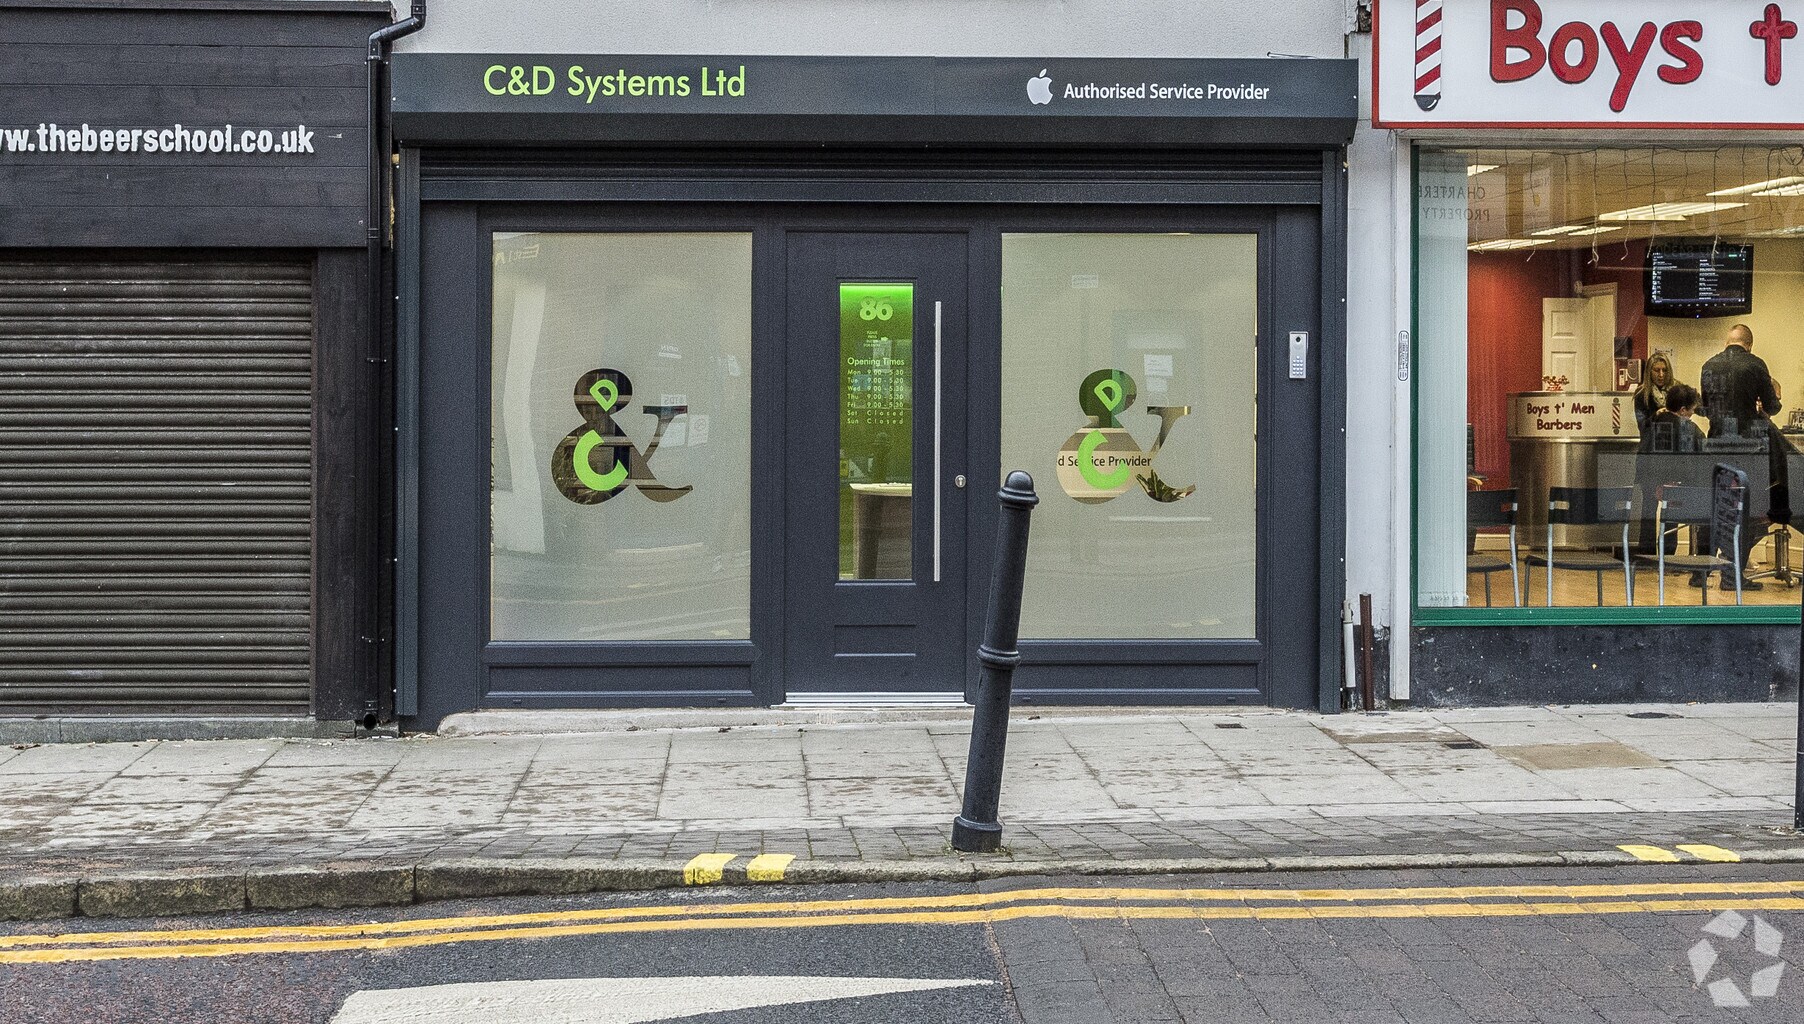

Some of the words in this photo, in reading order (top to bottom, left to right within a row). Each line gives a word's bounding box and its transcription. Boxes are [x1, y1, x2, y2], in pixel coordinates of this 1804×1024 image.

[483, 64, 556, 96] C&D
[567, 65, 691, 104] Systems
[701, 65, 745, 97] Ltd
[1063, 83, 1146, 100] Authorised
[1149, 83, 1203, 100] Service
[1207, 83, 1270, 100] Provider
[0, 123, 315, 154] w.thebeerschool.co.uk
[860, 296, 894, 322] 86
[847, 357, 881, 367] Opening
[882, 357, 905, 366] Times
[1527, 403, 1550, 417] Boys
[1554, 402, 1565, 414] t'
[1571, 403, 1595, 414] Men
[1536, 419, 1583, 430] Barbers
[1067, 455, 1106, 467] Seice
